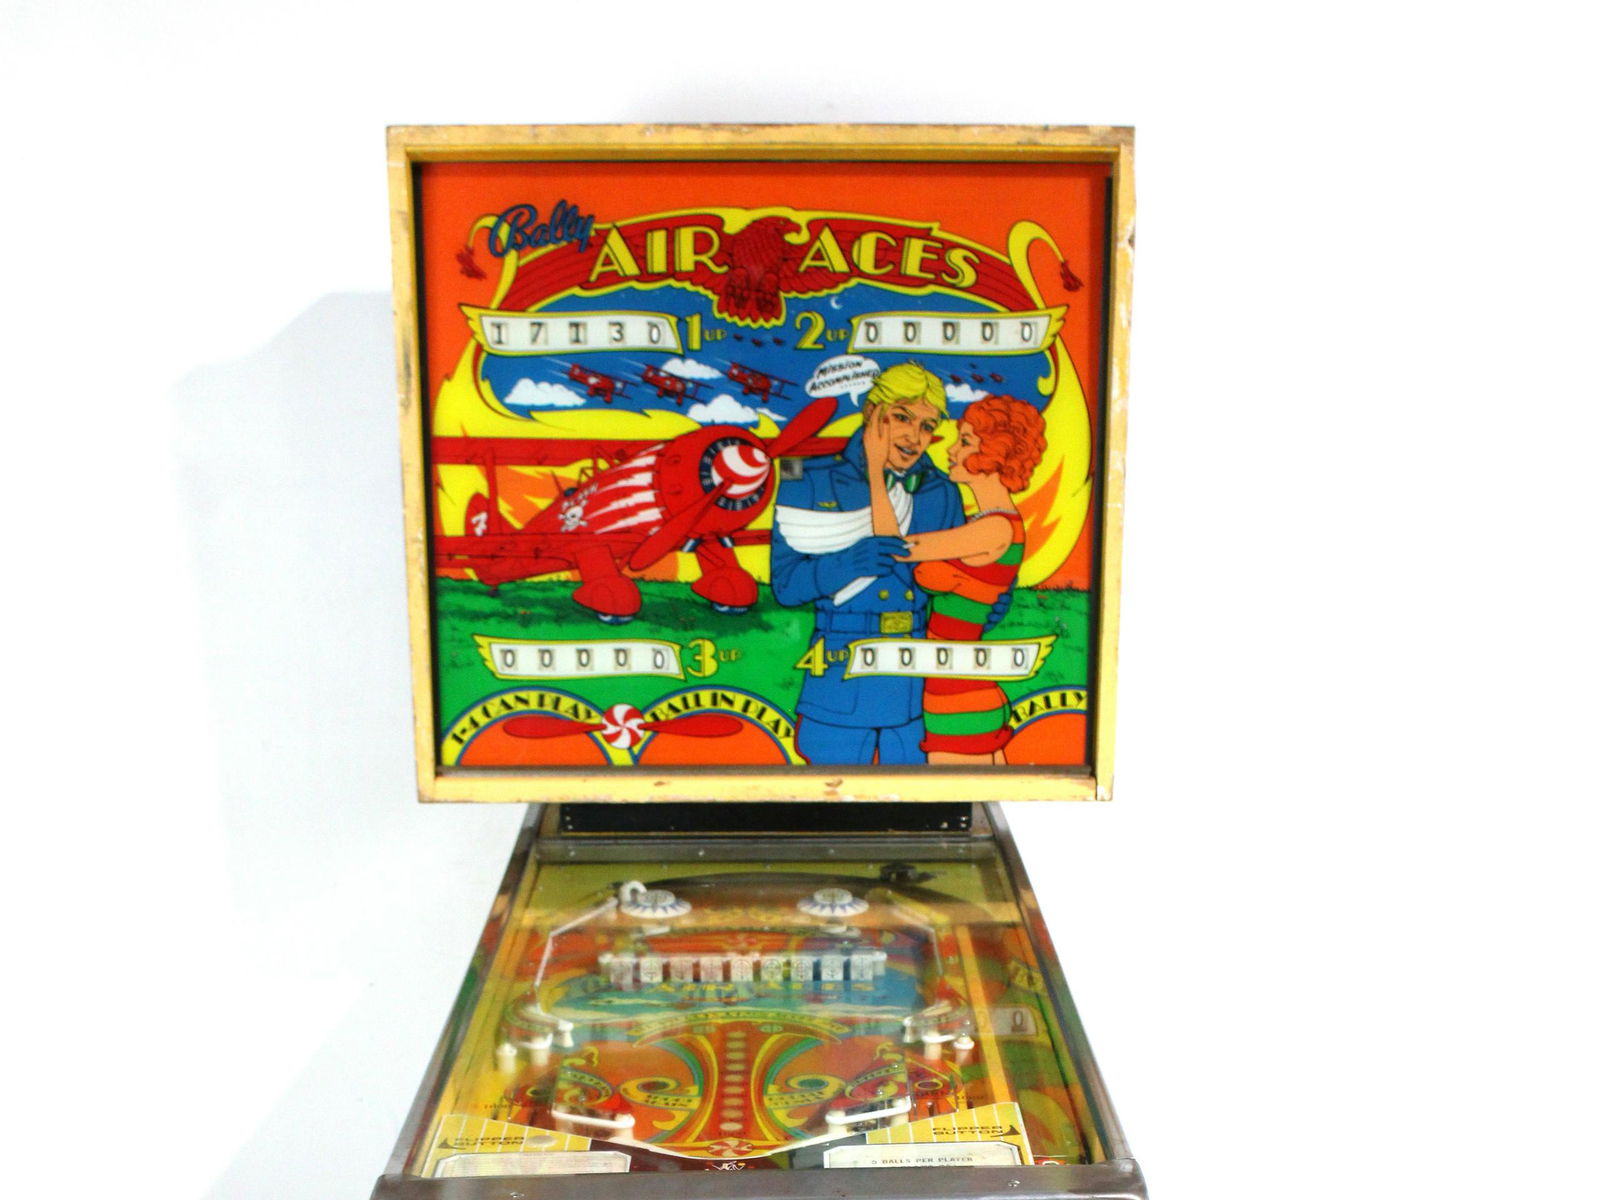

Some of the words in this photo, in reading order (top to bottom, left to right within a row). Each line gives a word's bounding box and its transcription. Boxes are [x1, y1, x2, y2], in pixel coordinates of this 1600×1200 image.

[489, 200, 595, 257] Bally
[589, 223, 729, 283] AIR
[798, 223, 981, 288] ACES
[711, 691, 736, 707] IN
